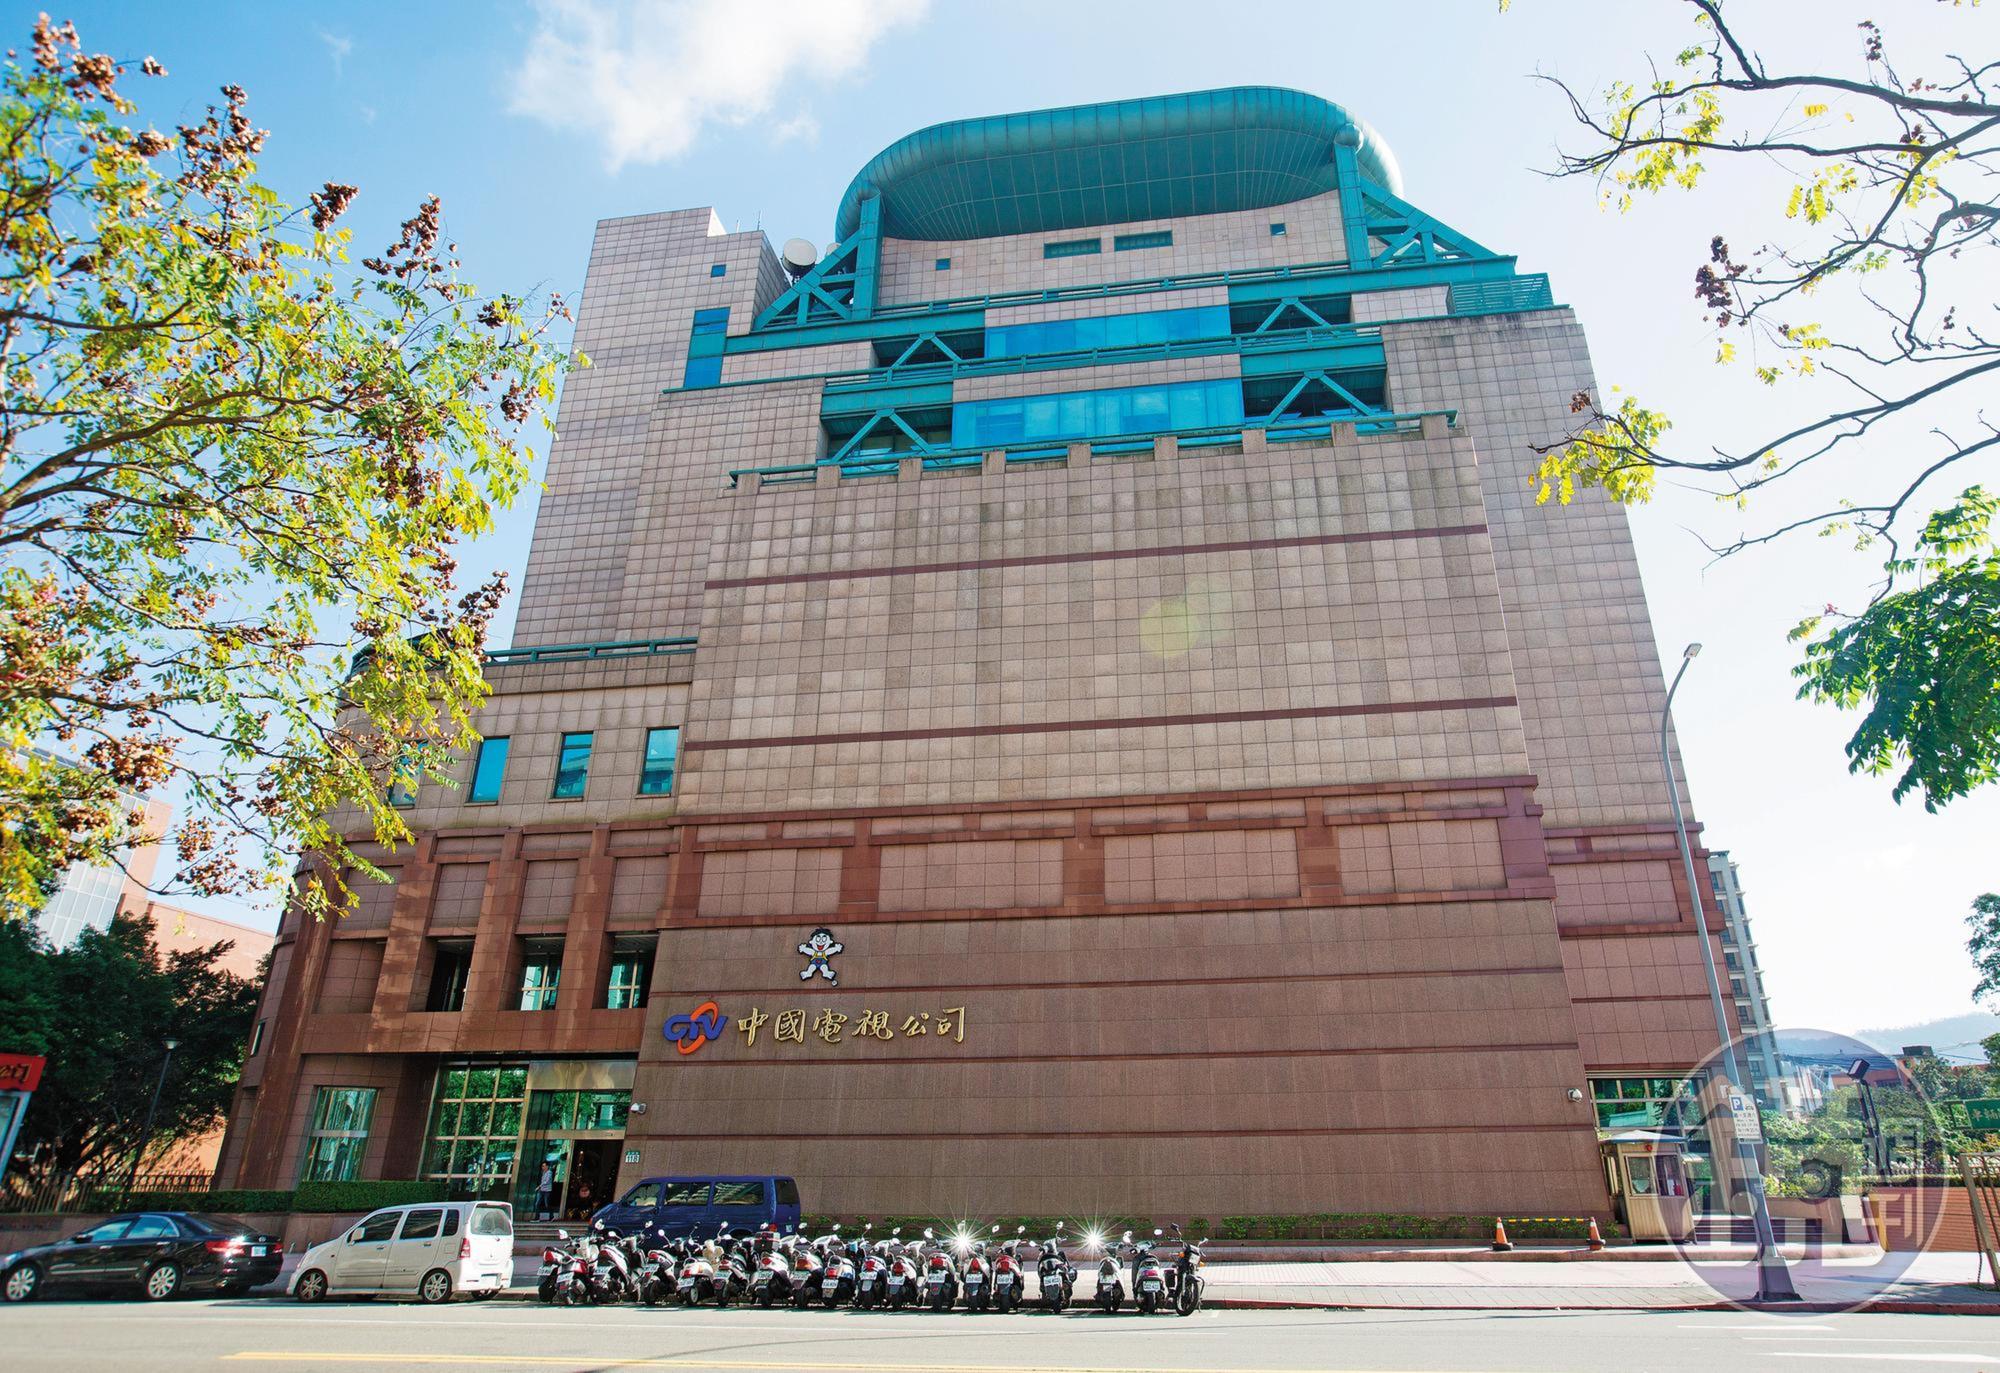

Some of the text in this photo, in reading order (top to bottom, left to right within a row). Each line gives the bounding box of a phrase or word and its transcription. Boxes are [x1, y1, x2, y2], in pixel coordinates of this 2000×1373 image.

[662, 1014, 728, 1041] CTV
[738, 1007, 965, 1047] 中國電視公司
